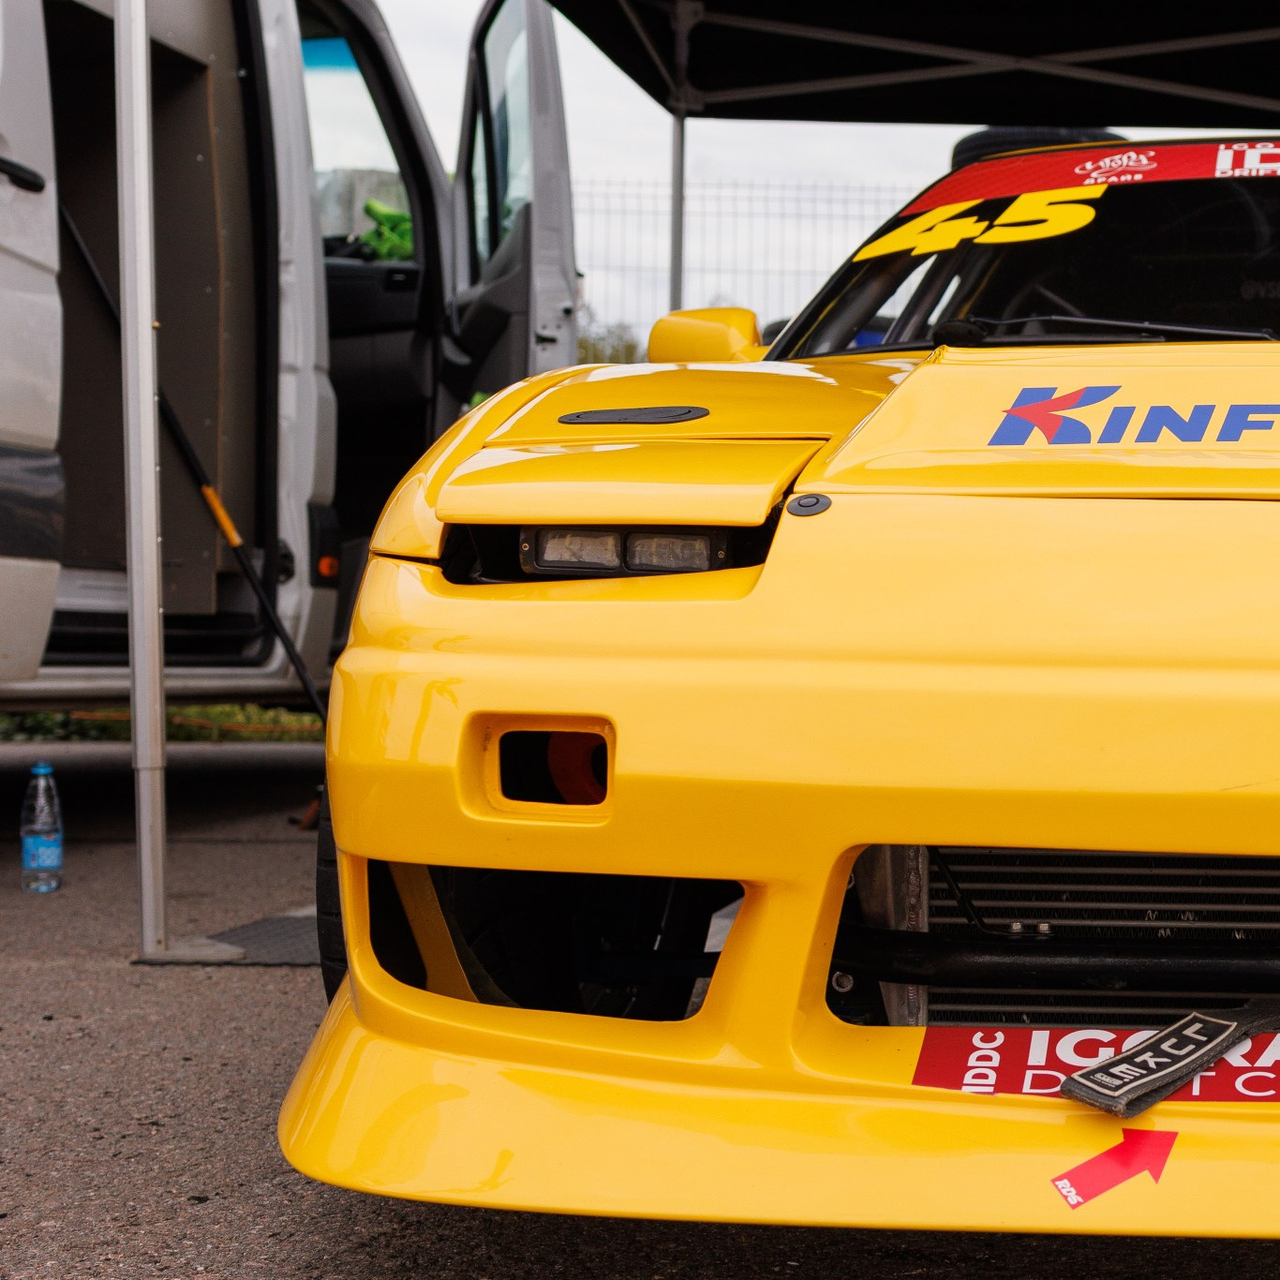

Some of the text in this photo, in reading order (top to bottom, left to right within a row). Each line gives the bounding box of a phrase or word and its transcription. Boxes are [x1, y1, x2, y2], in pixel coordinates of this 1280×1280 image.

[852, 184, 1109, 262] 45
[961, 1031, 1005, 1093] IDDC
[1054, 1178, 1084, 1205] RDS
